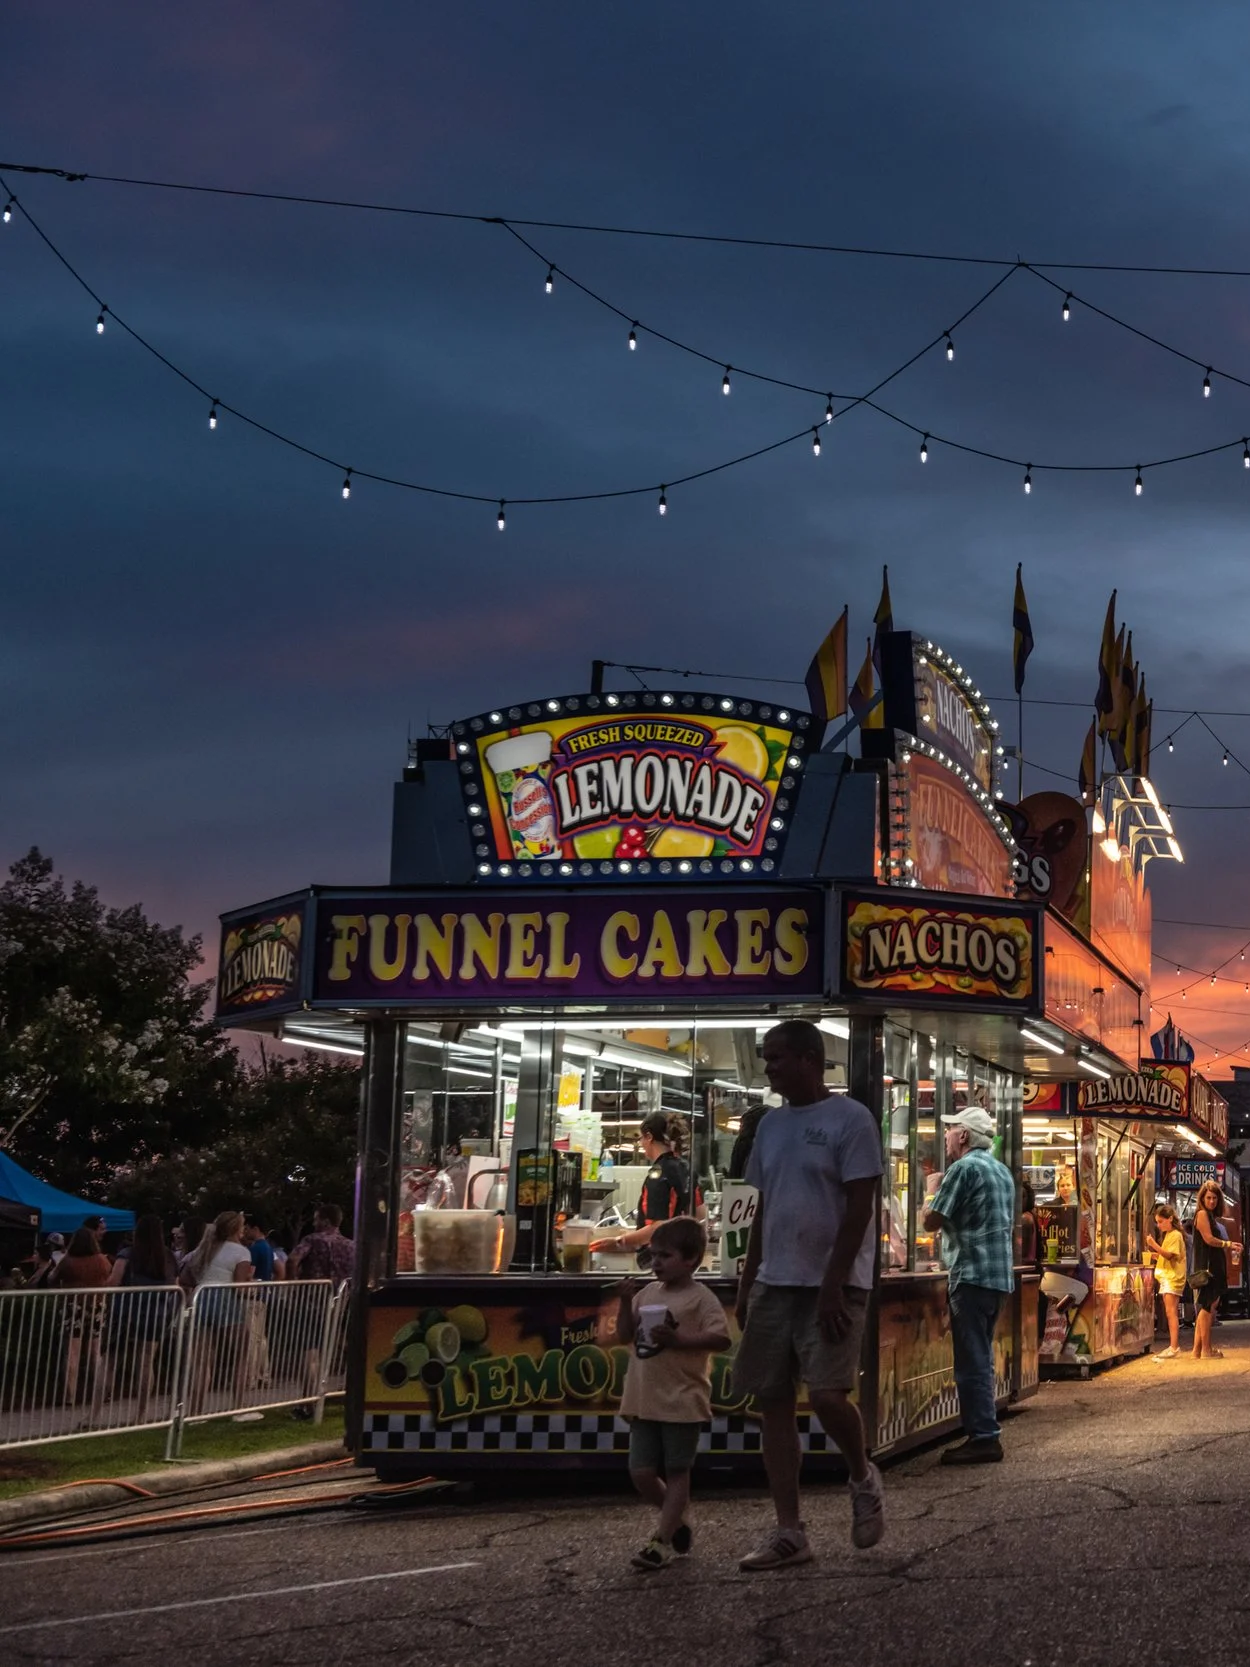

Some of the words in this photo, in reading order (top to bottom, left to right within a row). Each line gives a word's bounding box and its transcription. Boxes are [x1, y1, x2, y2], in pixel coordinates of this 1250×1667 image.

[568, 728, 621, 753] FRESH
[623, 724, 705, 747] SQUEEZED
[936, 680, 975, 759] NACHOS
[554, 755, 766, 842] LEMONADE
[226, 939, 296, 997] LEMONADE
[327, 911, 581, 981] FUNNEL
[599, 908, 810, 978] CAKES
[866, 920, 1018, 982] NACHOS
[1086, 1073, 1182, 1111] LEMONADE
[1178, 1164, 1191, 1172] ICE
[1194, 1164, 1215, 1172] COLD
[1051, 1225, 1070, 1239] Hot
[559, 1321, 599, 1347] Fresh
